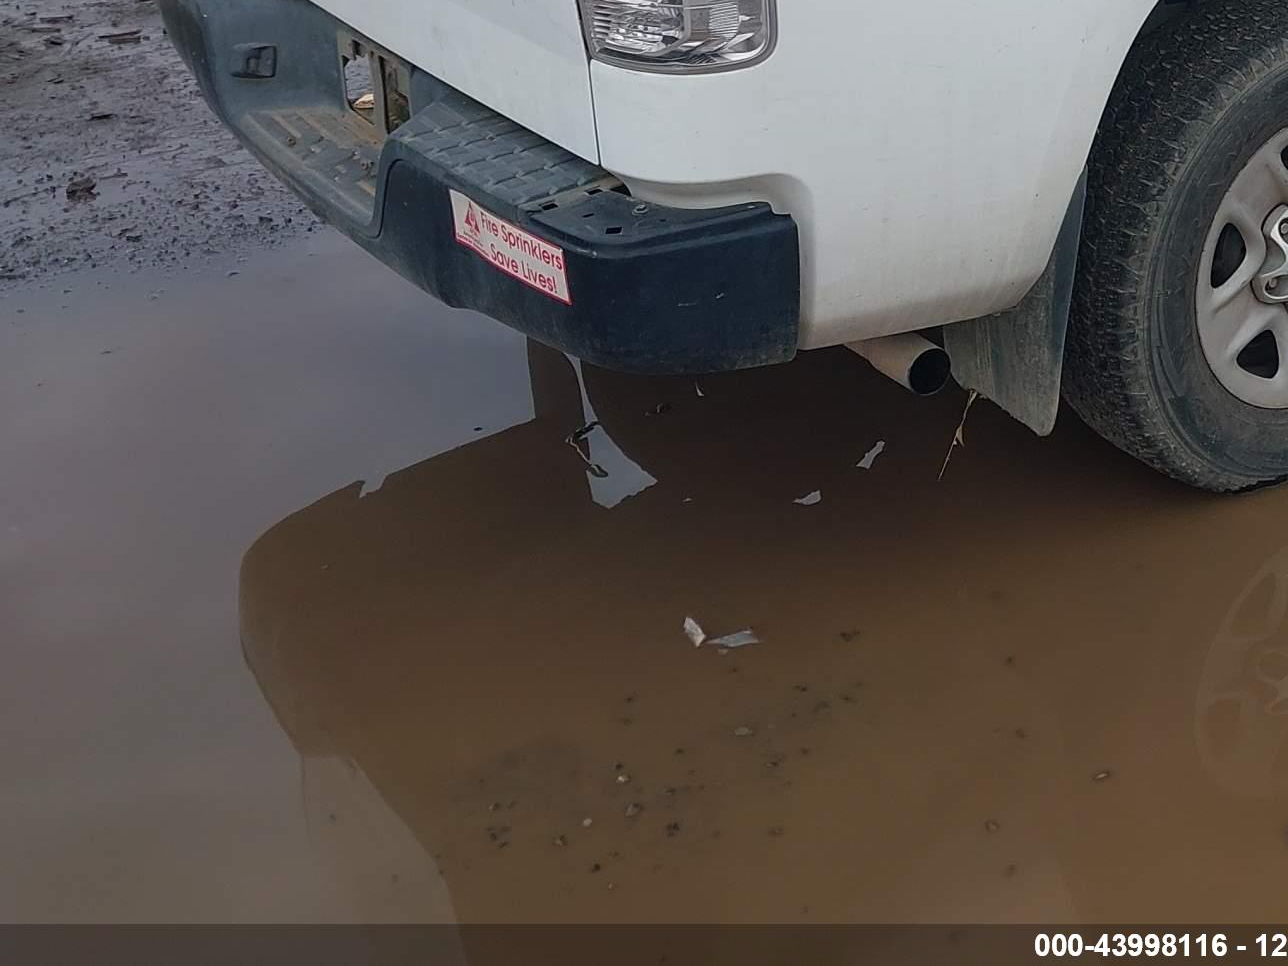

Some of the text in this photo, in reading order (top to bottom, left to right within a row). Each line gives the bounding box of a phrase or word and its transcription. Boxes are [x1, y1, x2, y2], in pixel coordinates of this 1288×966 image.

[480, 212, 499, 236] Fire
[501, 225, 563, 270] Sprinklers
[489, 243, 519, 274] Save
[521, 259, 558, 294] Lives!
